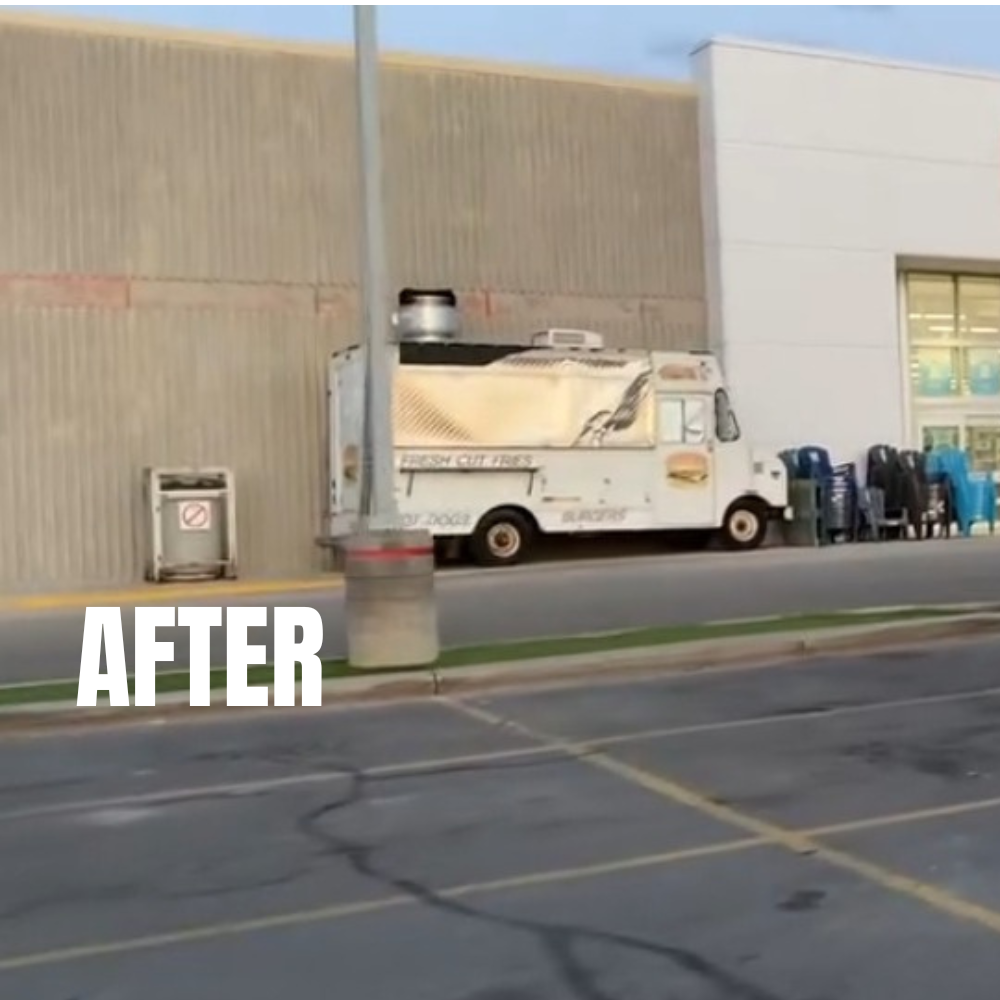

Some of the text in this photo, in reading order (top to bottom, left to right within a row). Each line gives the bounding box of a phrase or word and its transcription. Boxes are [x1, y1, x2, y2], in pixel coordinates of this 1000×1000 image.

[400, 454, 534, 468] FRESH CUT FRIES
[561, 508, 628, 523] BURGERS
